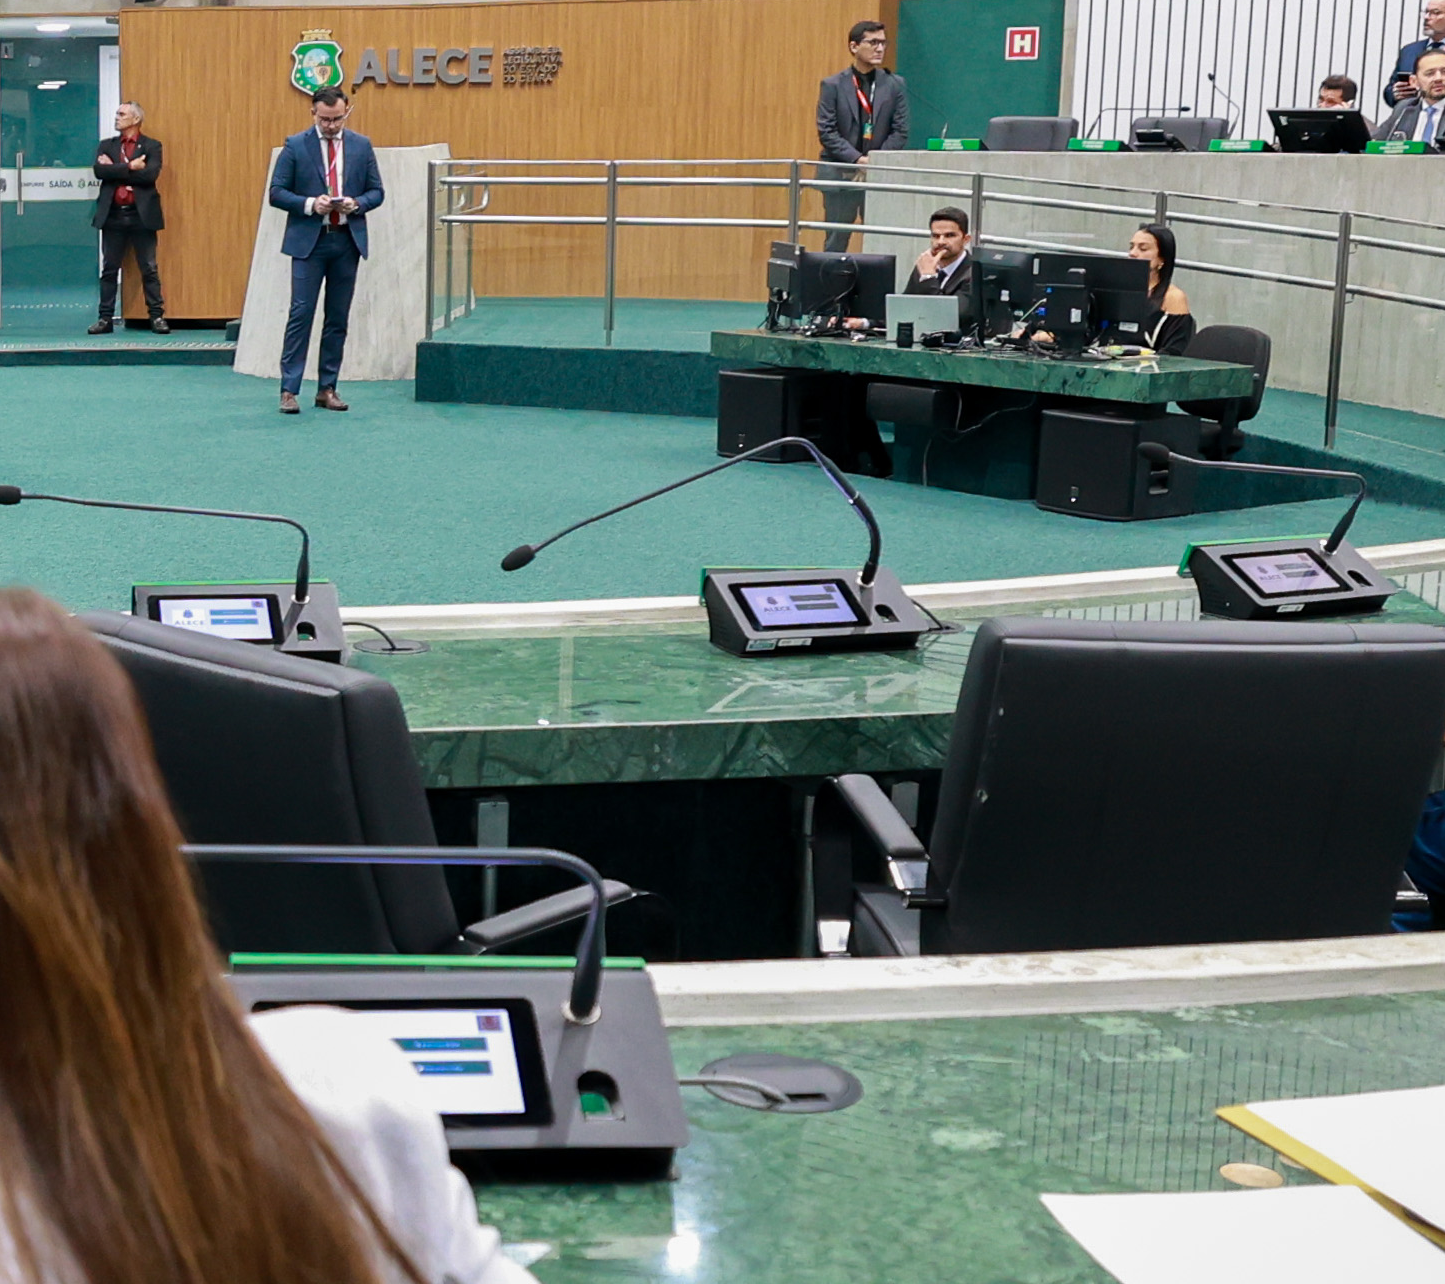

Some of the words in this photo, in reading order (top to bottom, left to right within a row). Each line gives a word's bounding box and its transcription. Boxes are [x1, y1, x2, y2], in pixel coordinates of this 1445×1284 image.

[1013, 33, 1032, 54] H
[352, 47, 494, 84] ALECE
[502, 65, 517, 74] DO
[520, 64, 558, 74] ESTADO
[502, 74, 516, 83] DO
[49, 178, 73, 188] SAÍDA
